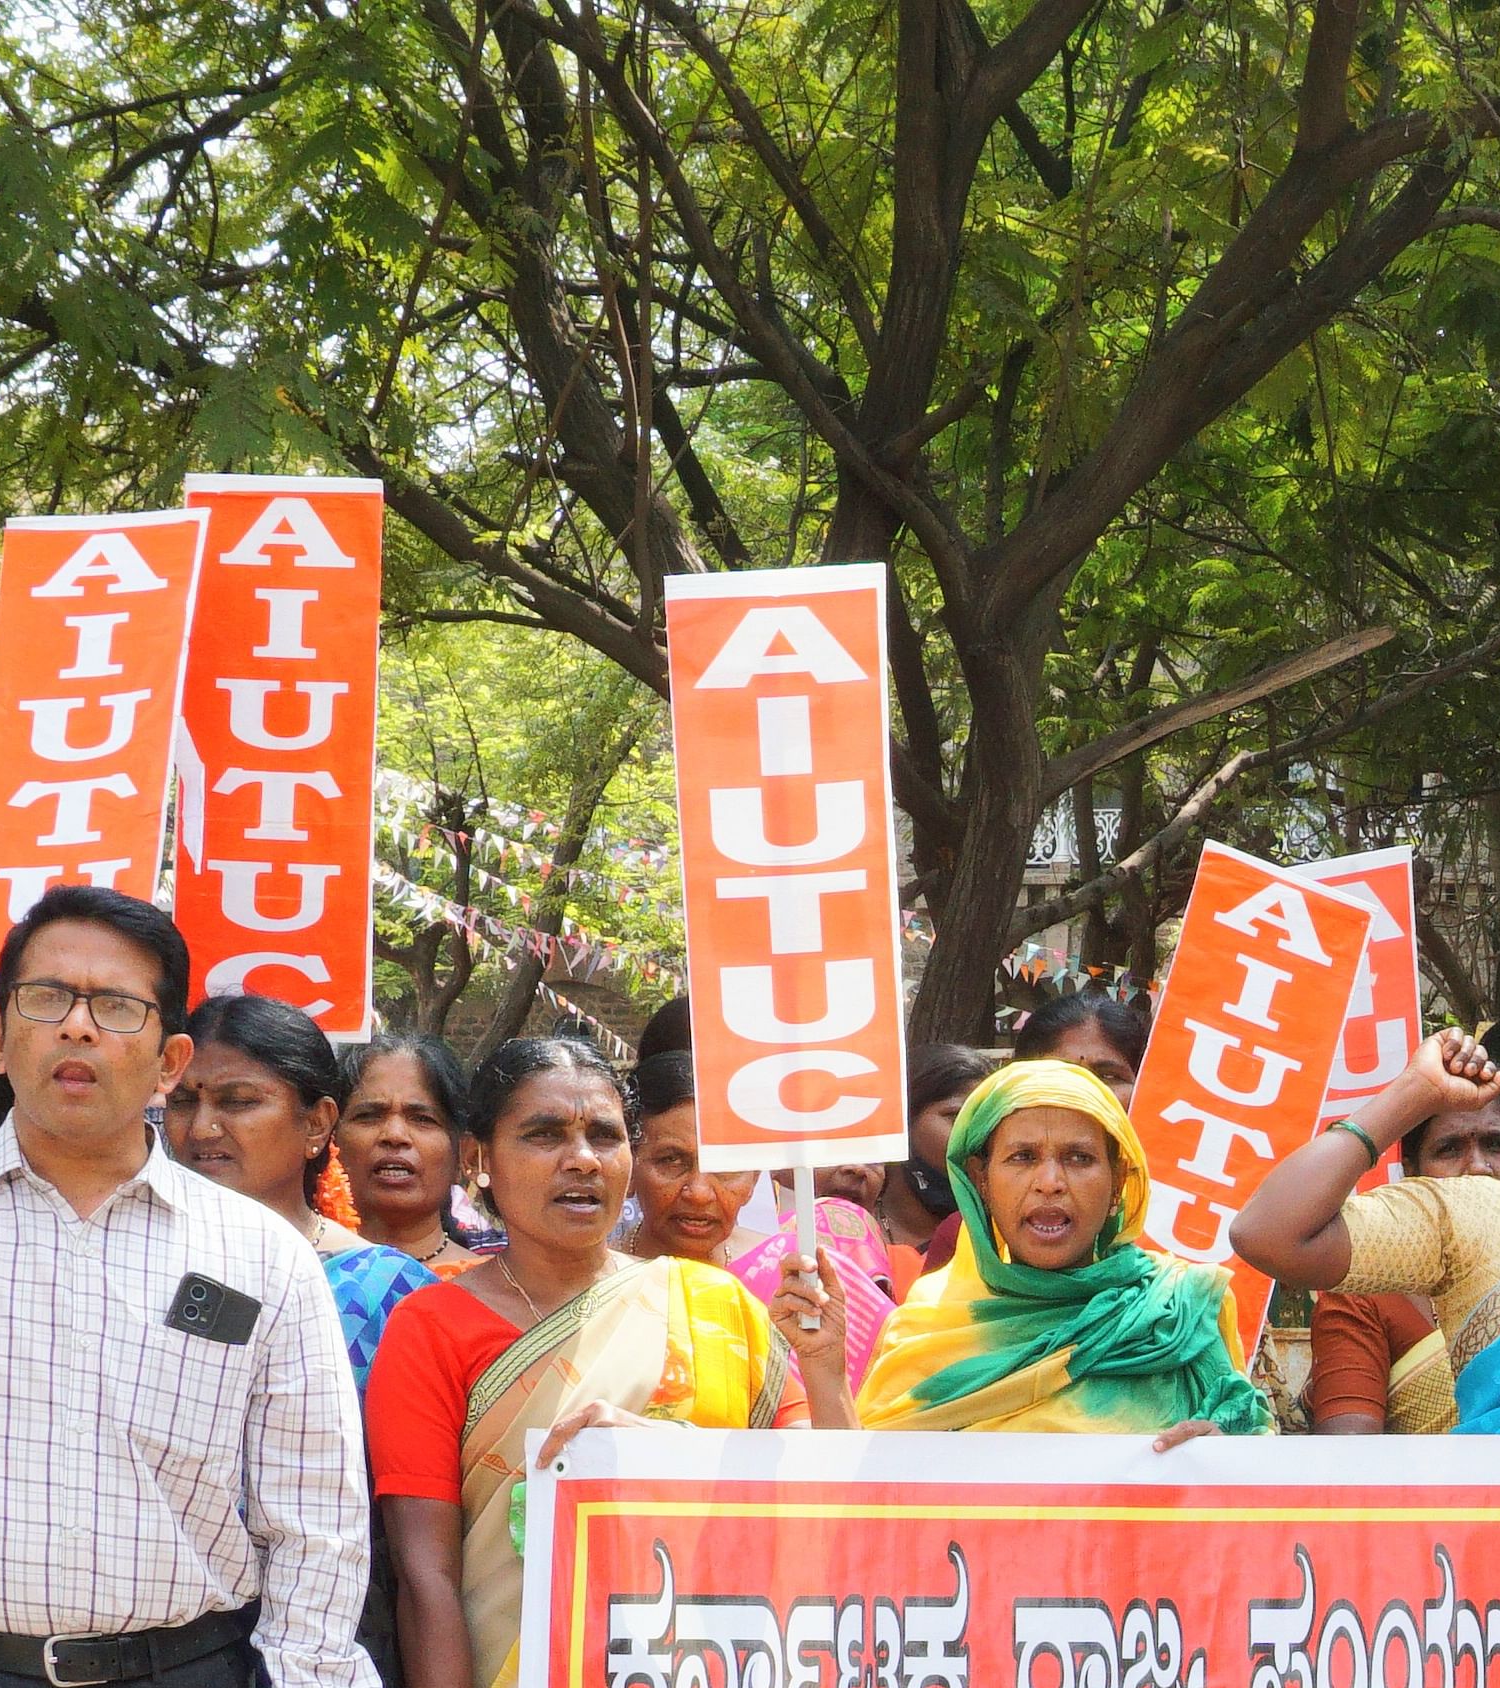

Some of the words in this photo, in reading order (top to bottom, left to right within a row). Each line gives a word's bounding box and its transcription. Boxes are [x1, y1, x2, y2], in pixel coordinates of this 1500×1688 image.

[204, 498, 356, 1018] AIUTUC
[694, 606, 882, 1132] AIUTUC
[1145, 882, 1333, 1264] AIUTU
